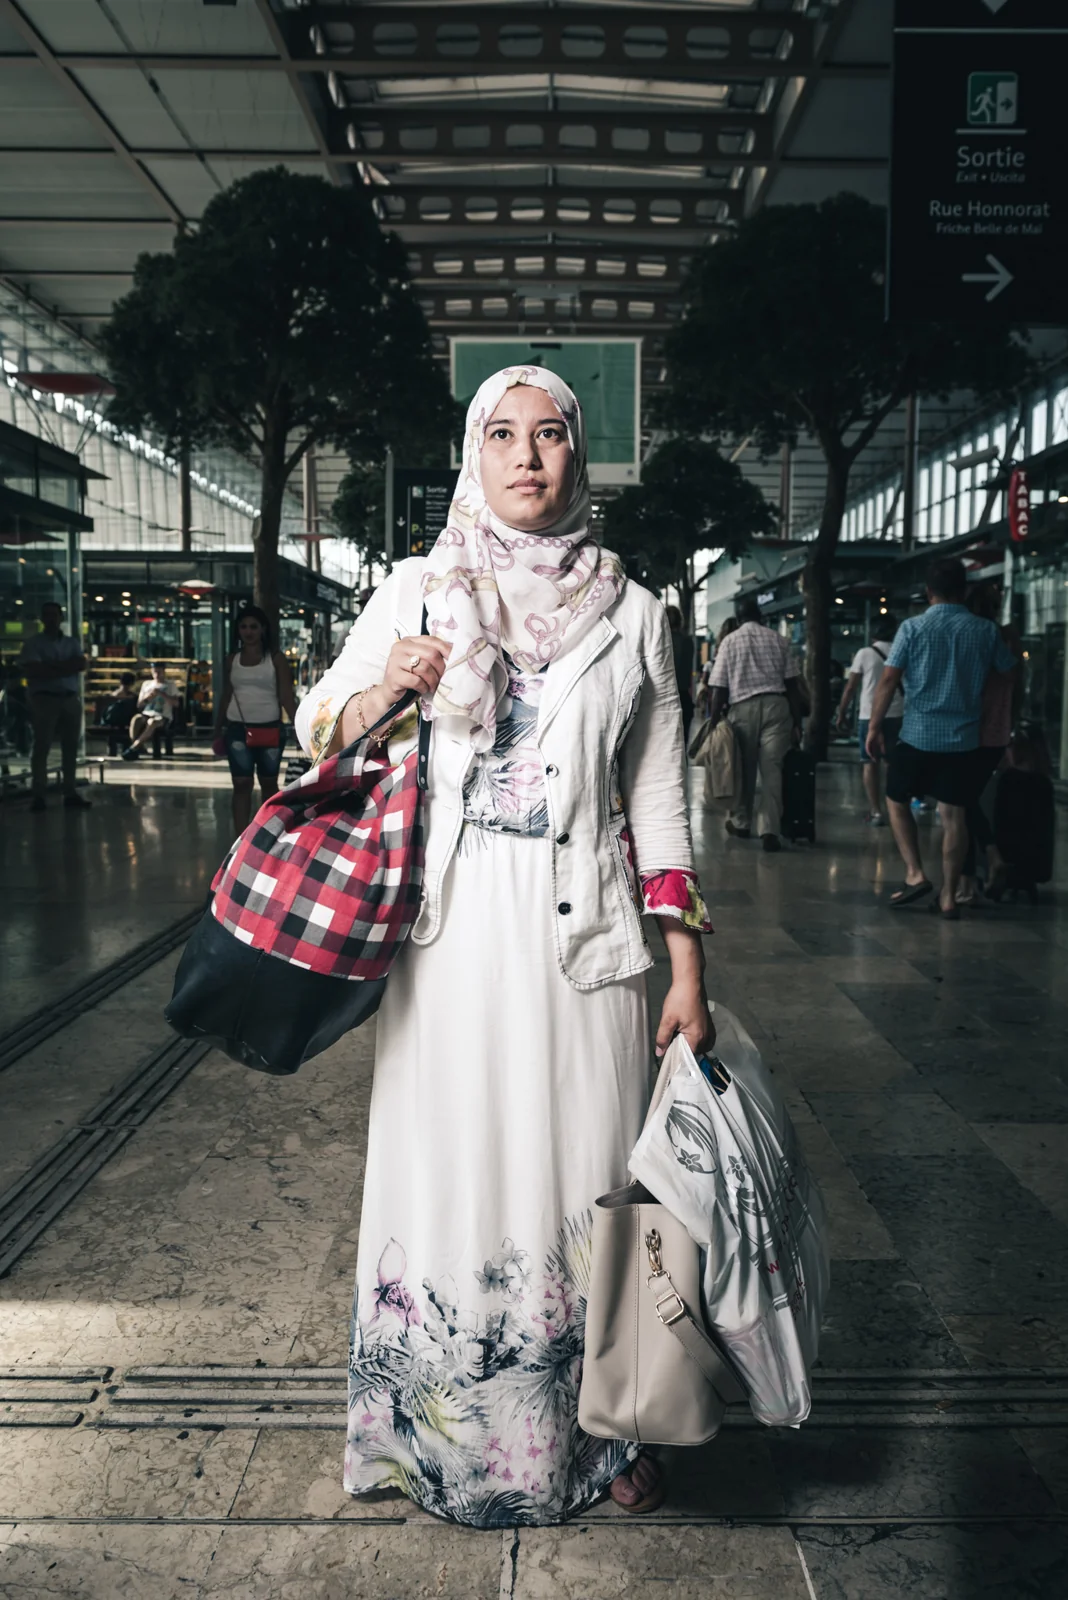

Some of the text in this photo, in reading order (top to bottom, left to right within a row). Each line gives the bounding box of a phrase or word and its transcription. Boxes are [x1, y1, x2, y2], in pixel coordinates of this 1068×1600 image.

[956, 145, 1026, 168] Sortie
[956, 171, 1026, 183] Exit Uscita
[929, 199, 1051, 218] Rue Honnorat
[936, 222, 972, 235] Friche
[973, 223, 1003, 235] Belle
[1004, 223, 1019, 235] de
[1016, 472, 1028, 536] TABAC
